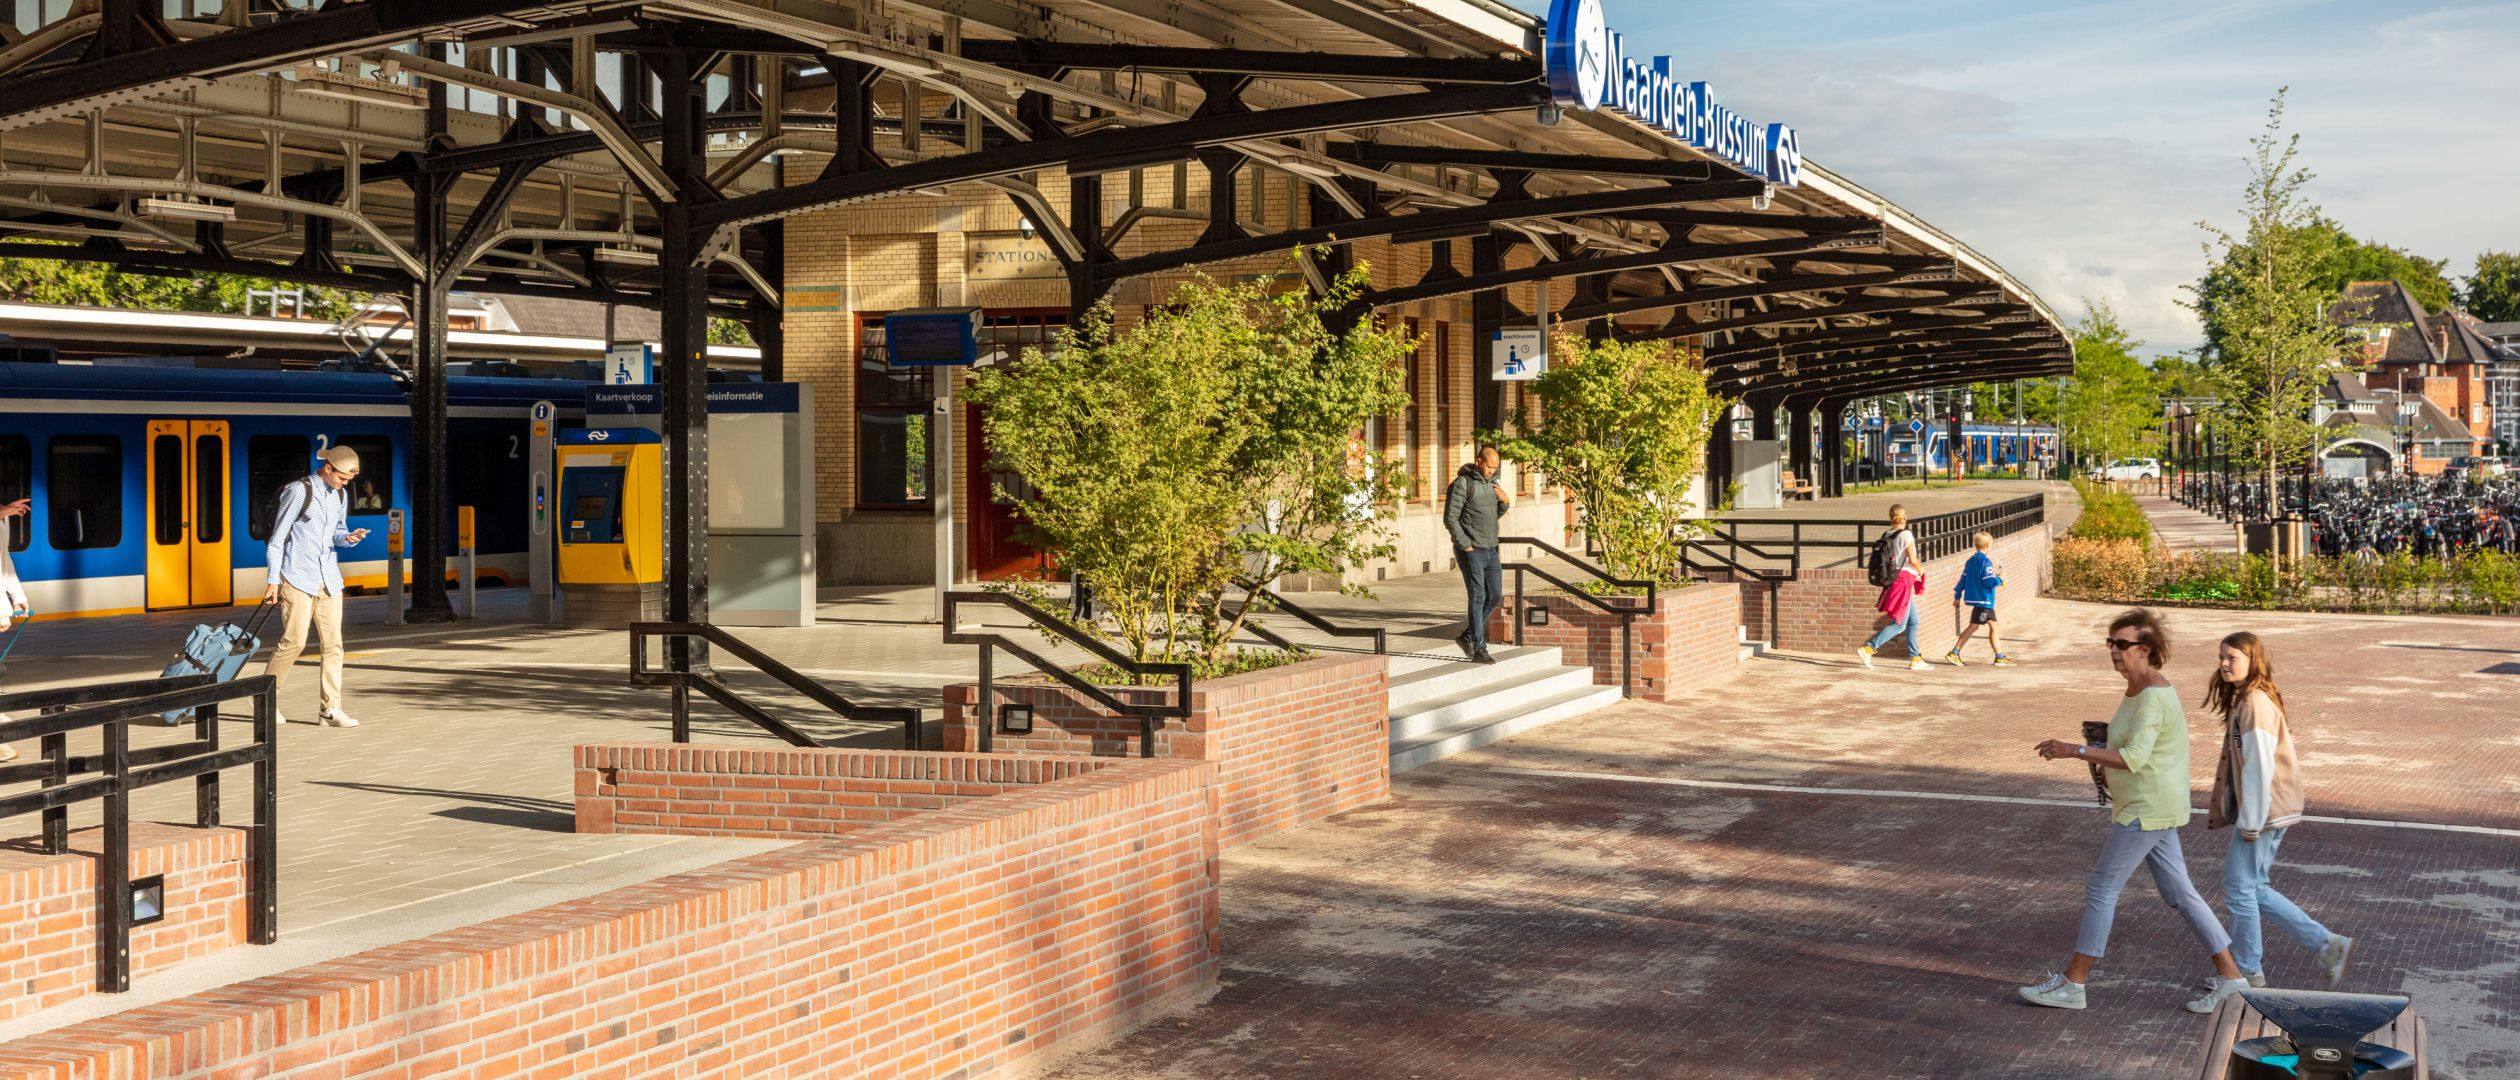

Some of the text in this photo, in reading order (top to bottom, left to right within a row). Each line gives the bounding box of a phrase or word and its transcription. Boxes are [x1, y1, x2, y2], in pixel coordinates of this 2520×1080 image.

[1606, 27, 1766, 176] Naarden-Bussum
[595, 393, 653, 403] Kaartverkoop
[705, 391, 764, 401] eisinformatie
[316, 434, 328, 460] 2
[509, 435, 519, 458] 2
